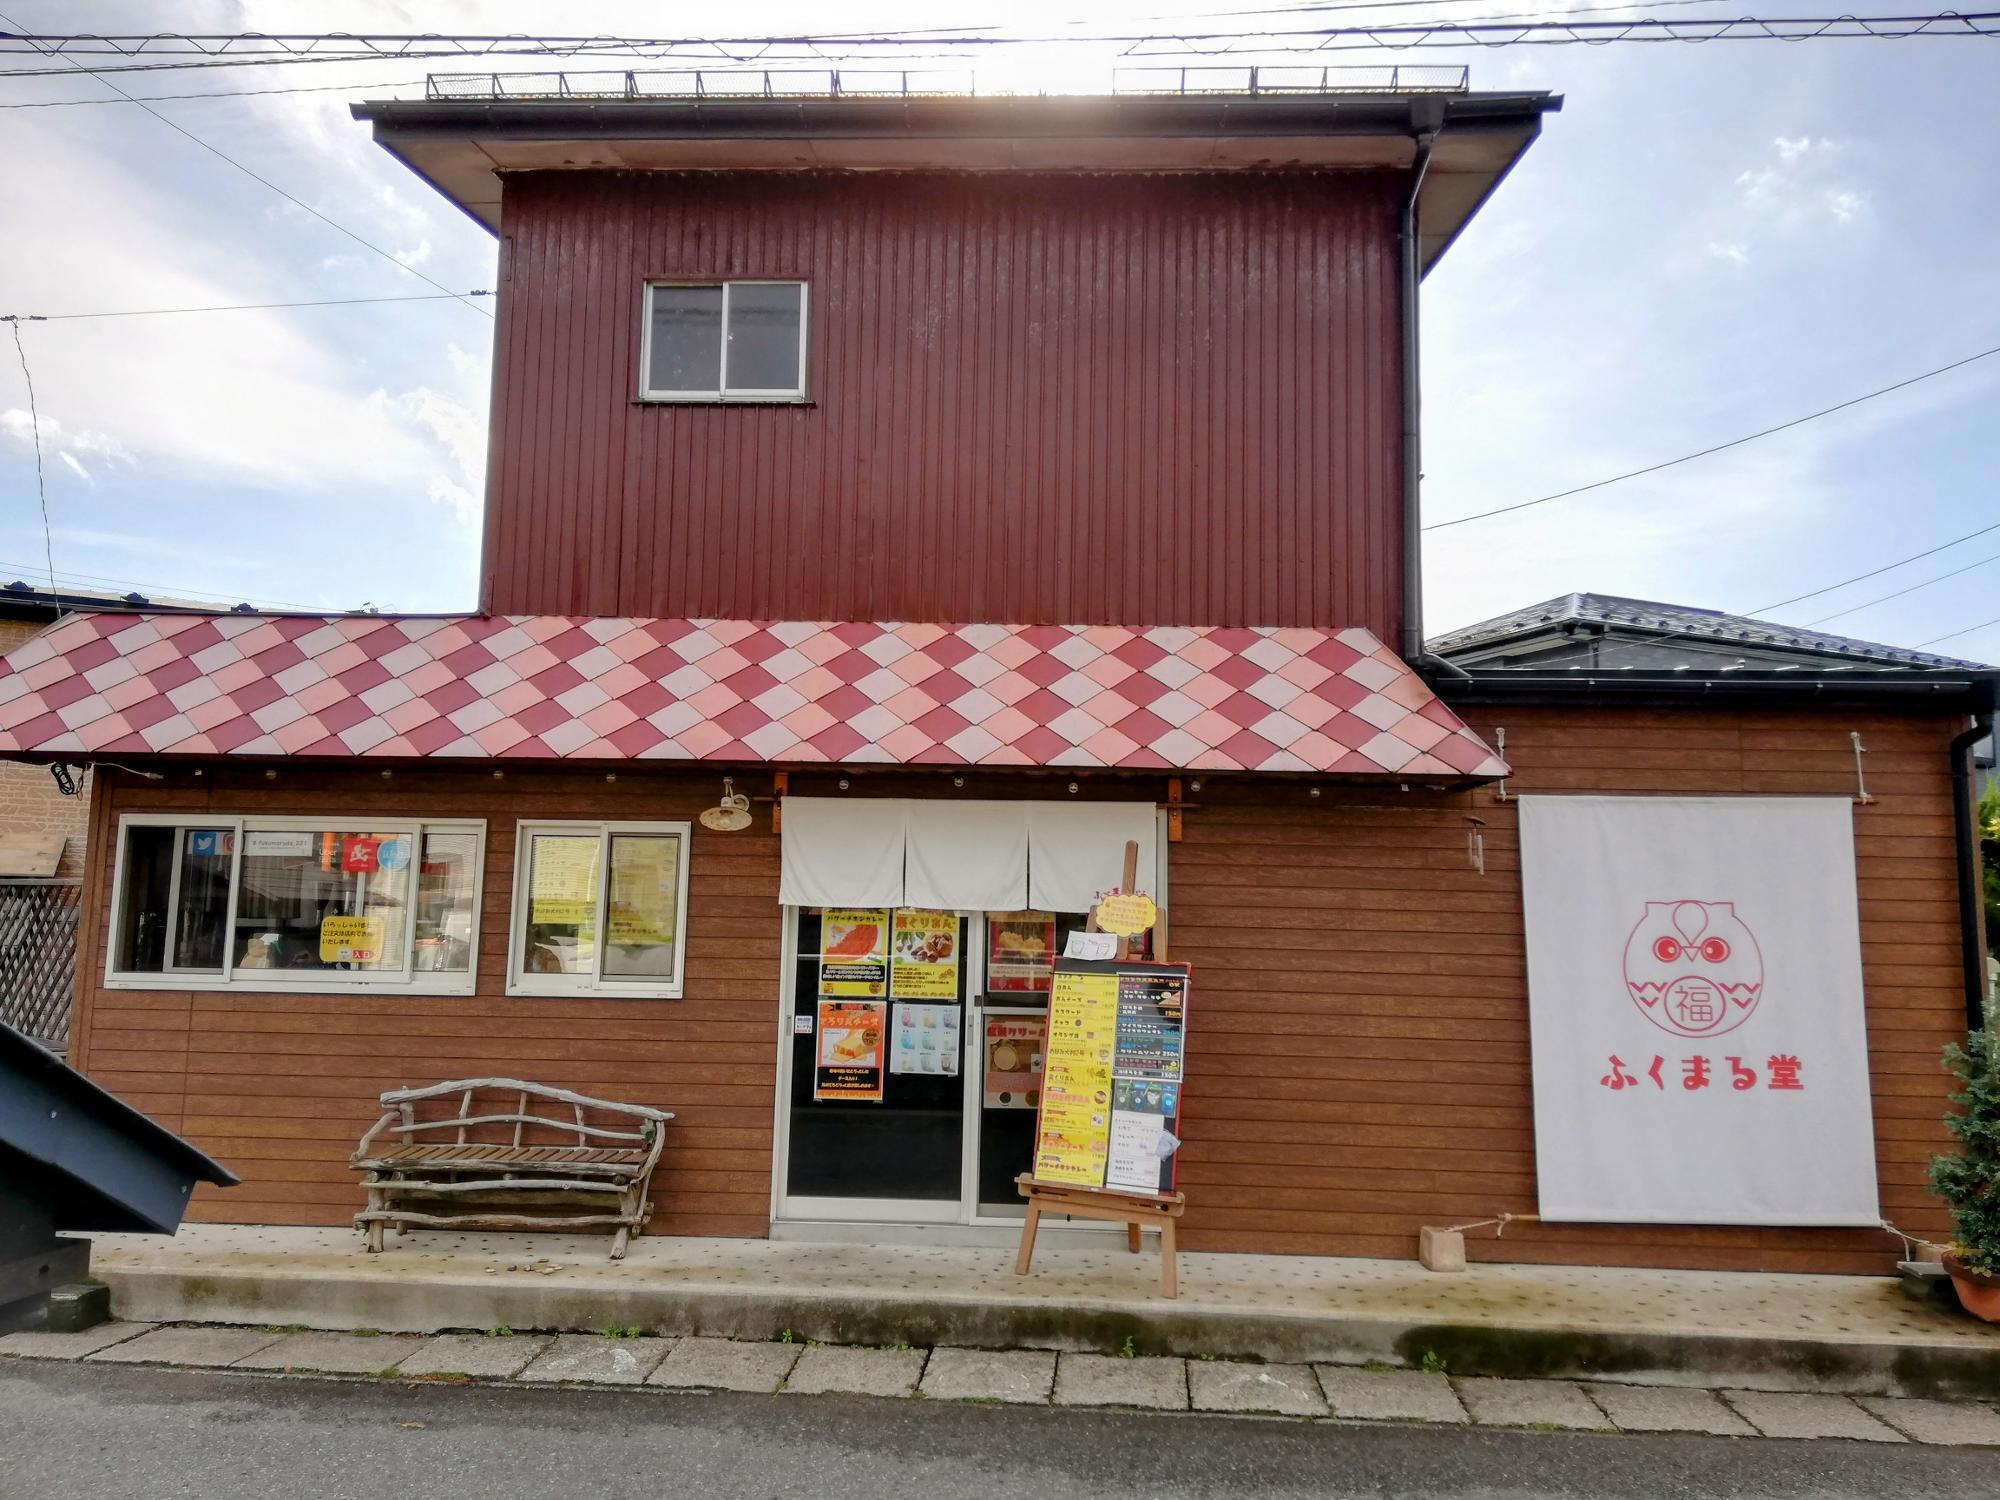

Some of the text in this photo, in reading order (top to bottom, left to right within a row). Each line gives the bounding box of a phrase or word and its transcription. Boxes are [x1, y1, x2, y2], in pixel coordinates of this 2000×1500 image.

[1674, 985, 1714, 1023] 福
[1600, 1054, 1804, 1091] ふくまる堂
